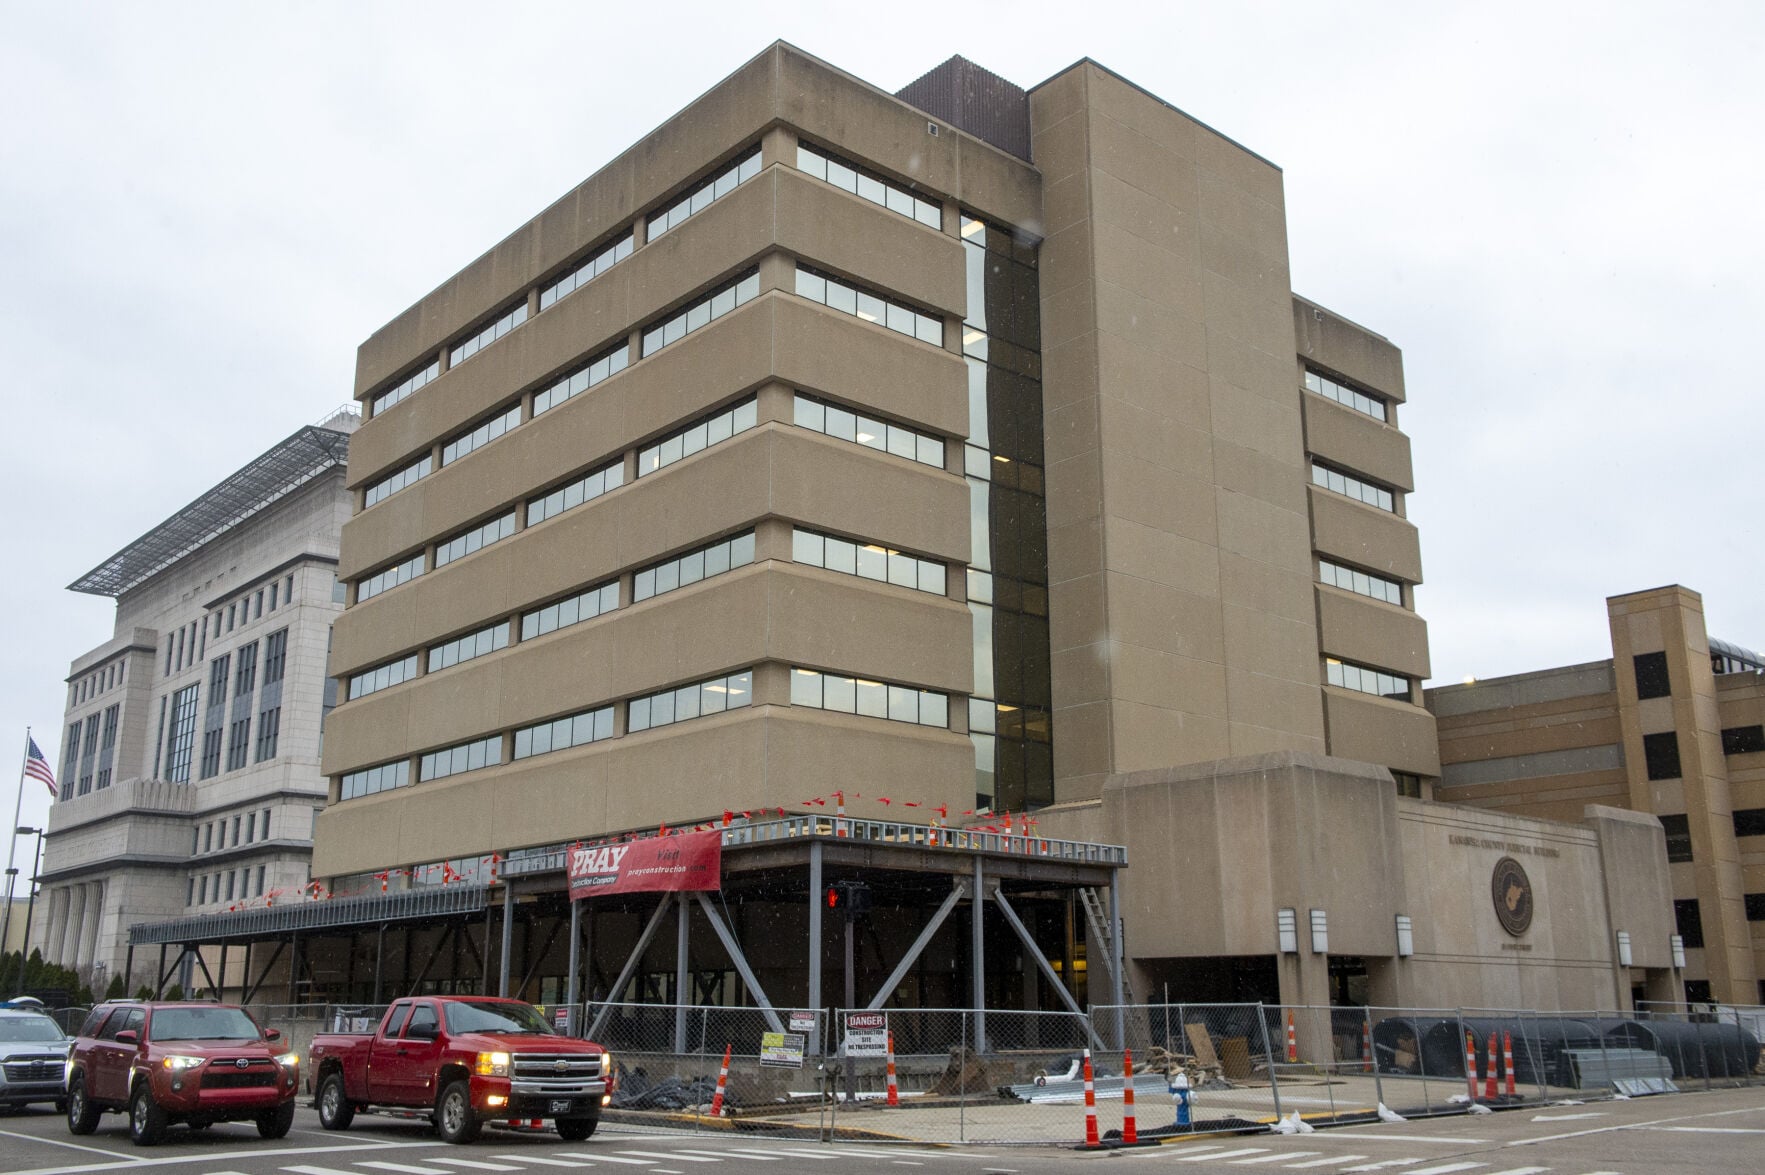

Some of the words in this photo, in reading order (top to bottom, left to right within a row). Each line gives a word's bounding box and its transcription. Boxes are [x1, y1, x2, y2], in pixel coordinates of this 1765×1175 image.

[657, 849, 681, 861] Visit
[570, 846, 629, 877] PRAY
[592, 875, 617, 886] Company
[850, 1015, 883, 1026] DANGER
